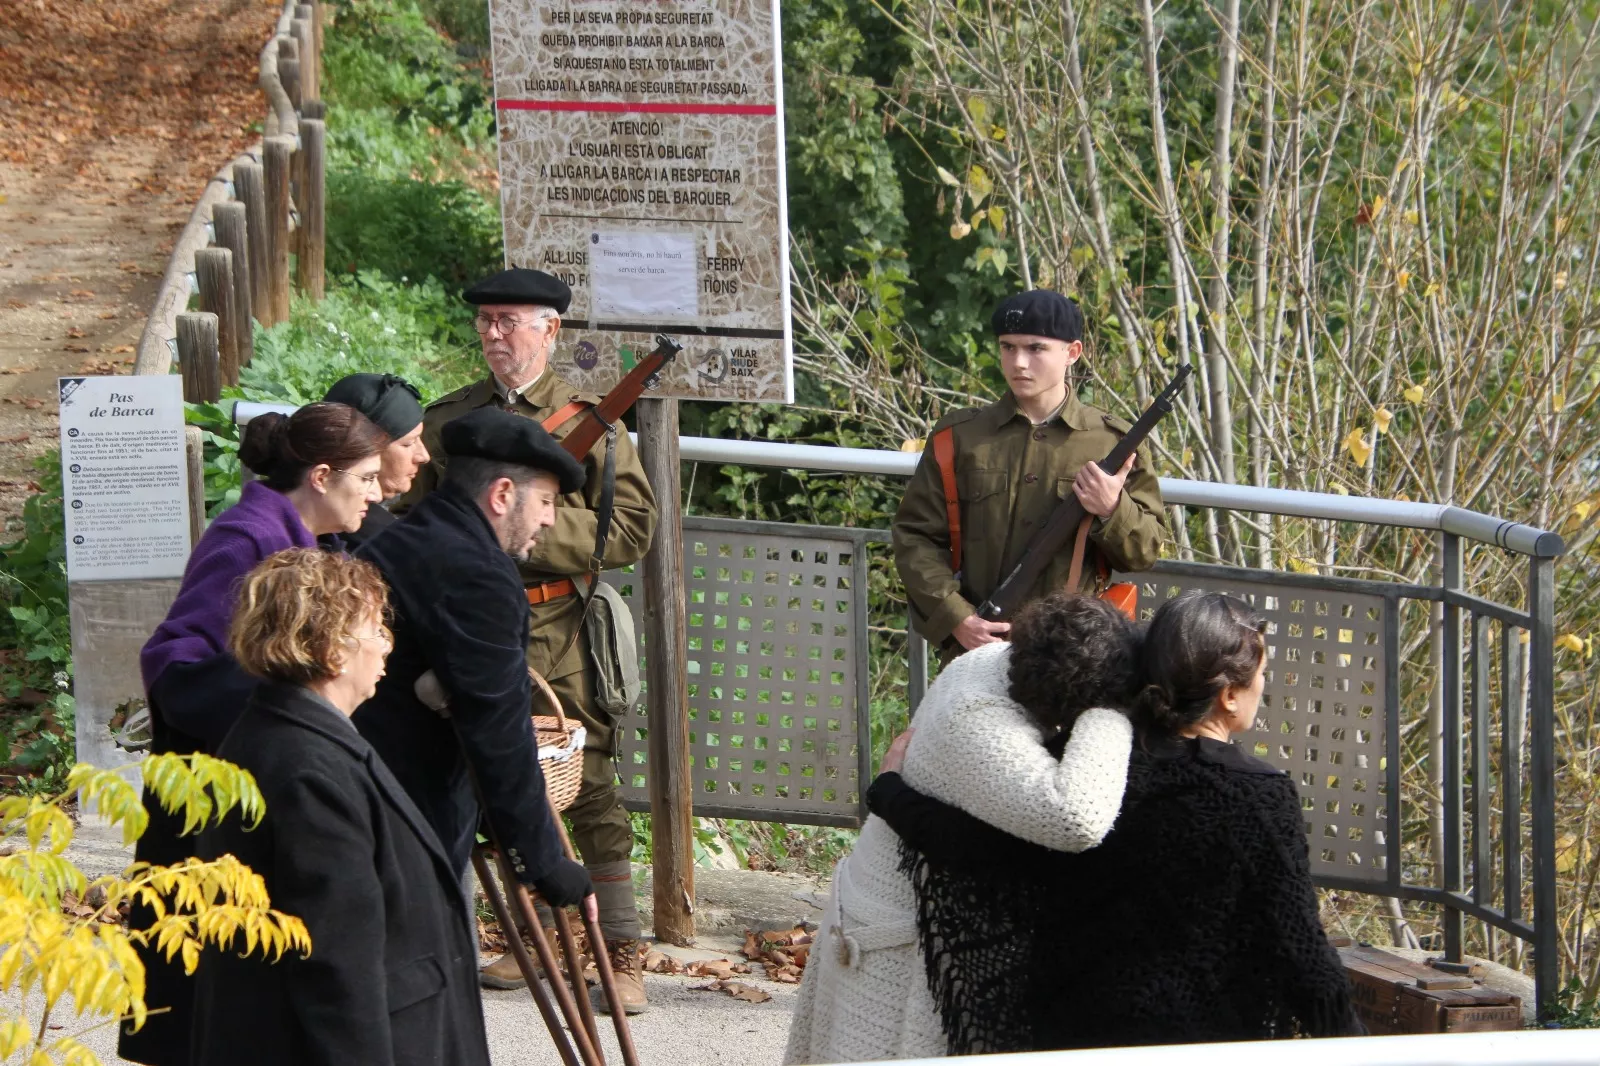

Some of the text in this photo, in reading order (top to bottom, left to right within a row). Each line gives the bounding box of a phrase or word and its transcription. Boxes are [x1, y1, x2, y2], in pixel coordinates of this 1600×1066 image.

[551, 10, 713, 25] PER LA SEVA PRÒPIA SEGURETAT
[542, 36, 725, 48] QUEDA PROHIBIT BAIXAR A LA BARCA
[553, 58, 715, 72] SI AQUESTA NO ESTA TOTALMENT
[524, 80, 748, 95] LLIGADA I LA BARRA DE SEGURETAT PASSADA
[610, 121, 664, 136] ATENCIÓ!
[569, 144, 708, 160] L'USUARI ESTÀ OBLIGAT
[540, 165, 740, 183] A LLIGAR LA BARCA I A RESPECTAR
[547, 188, 734, 206] LES INDICACIONS DEL BARQUER.
[544, 251, 564, 264] ALL
[567, 251, 588, 265] USE
[707, 257, 745, 271] FERRY
[731, 349, 757, 358] VILAR
[731, 368, 754, 376] BAIX
[110, 393, 134, 403] Pas
[89, 407, 154, 417] de Barca
